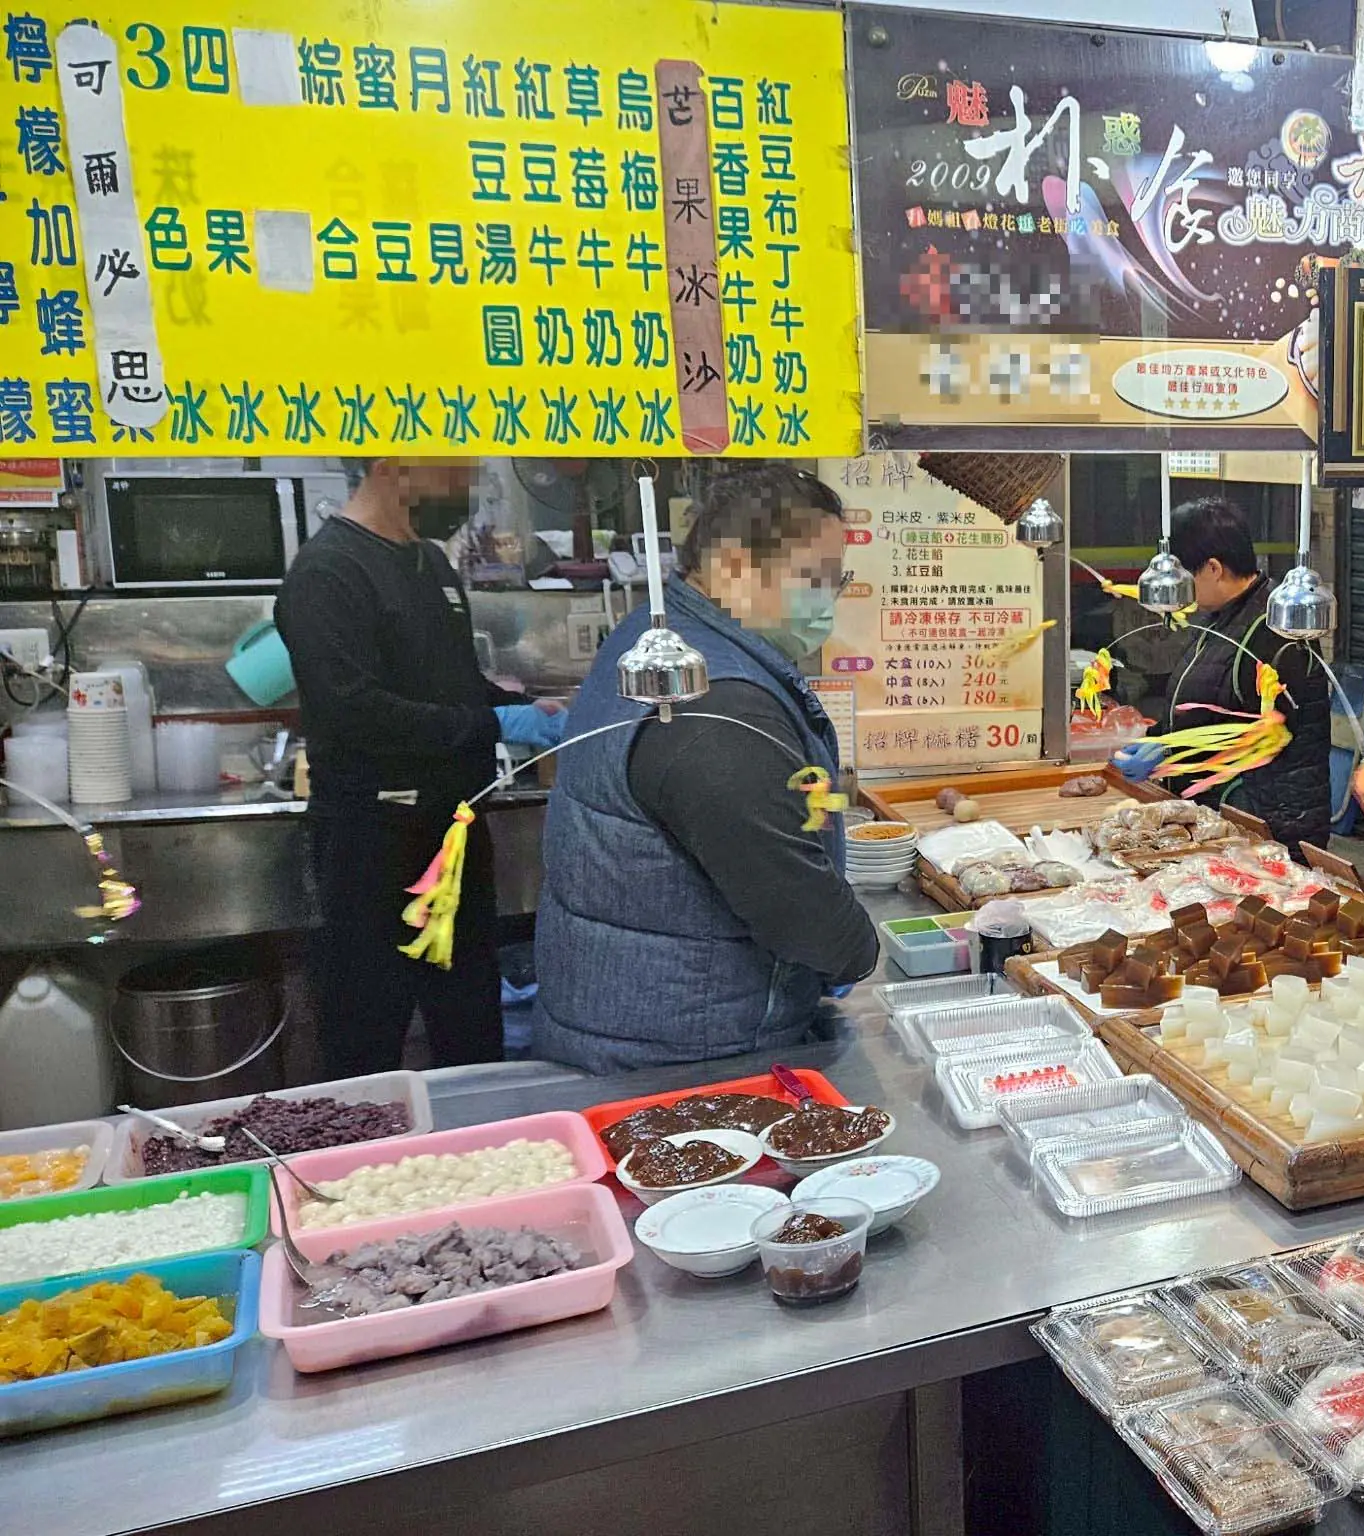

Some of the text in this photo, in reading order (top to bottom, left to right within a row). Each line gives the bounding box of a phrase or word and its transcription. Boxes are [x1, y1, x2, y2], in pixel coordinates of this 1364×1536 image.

[67, 59, 163, 403] 可爾必思
[462, 53, 531, 445] 紅豆湯圓冰
[513, 56, 582, 446] 紅豆牛奶冰
[563, 64, 632, 446] 草莓牛奶冰
[616, 67, 677, 446] 烏梅牛奶冰
[661, 86, 722, 392] 芒果冰沙
[708, 76, 767, 445] 百香果牛奶冰
[756, 77, 811, 446] 紅豆布丁牛奶冰
[906, 159, 992, 192] 2009
[906, 549, 943, 561] 花生餡
[906, 565, 943, 578] 紅豆餡
[963, 690, 996, 705] 180
